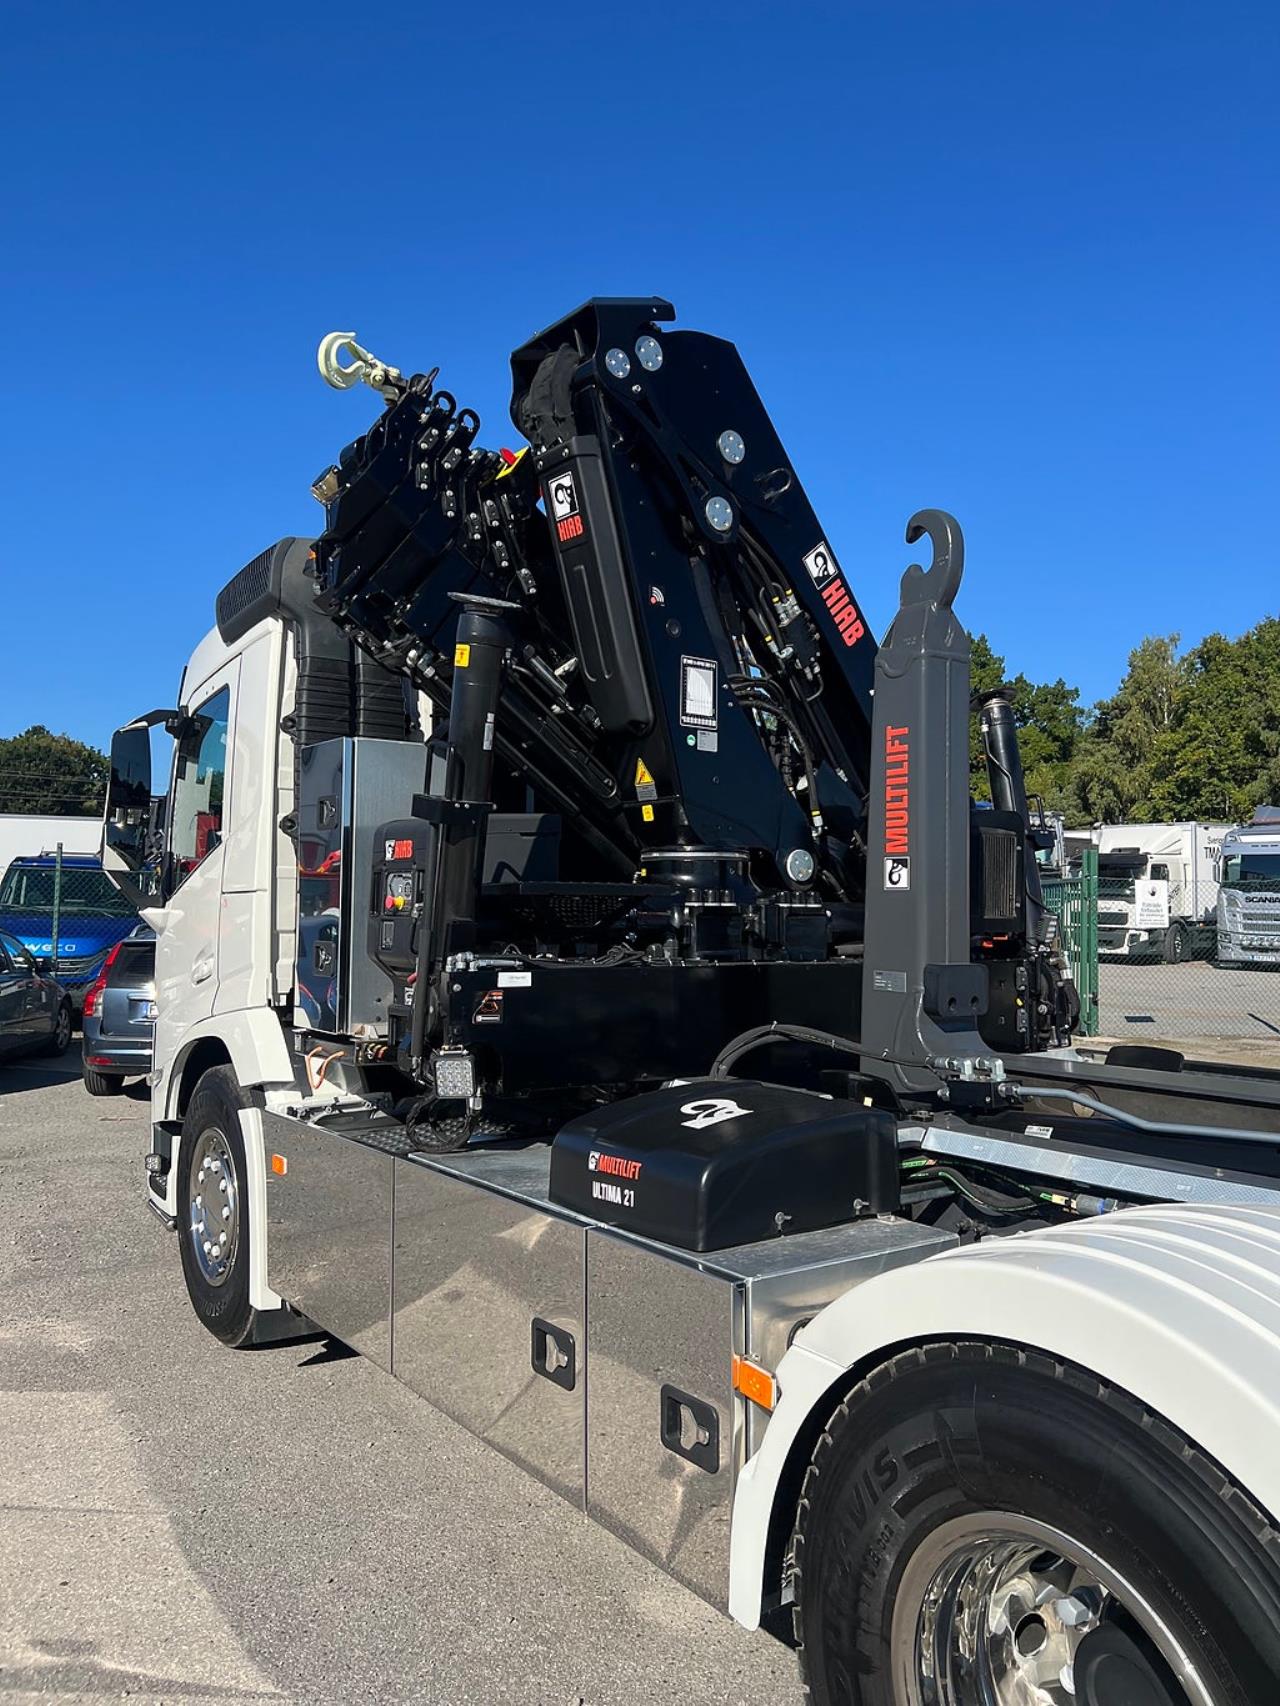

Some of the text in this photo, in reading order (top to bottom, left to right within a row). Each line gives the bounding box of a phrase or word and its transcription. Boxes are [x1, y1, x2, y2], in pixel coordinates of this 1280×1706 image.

[557, 515, 583, 542] HIAB
[821, 578, 865, 647] HIAB
[885, 725, 909, 853] MULTILIFT
[597, 1154, 642, 1180] MULTILIFT
[592, 1181, 635, 1208] ULTIMA 21
